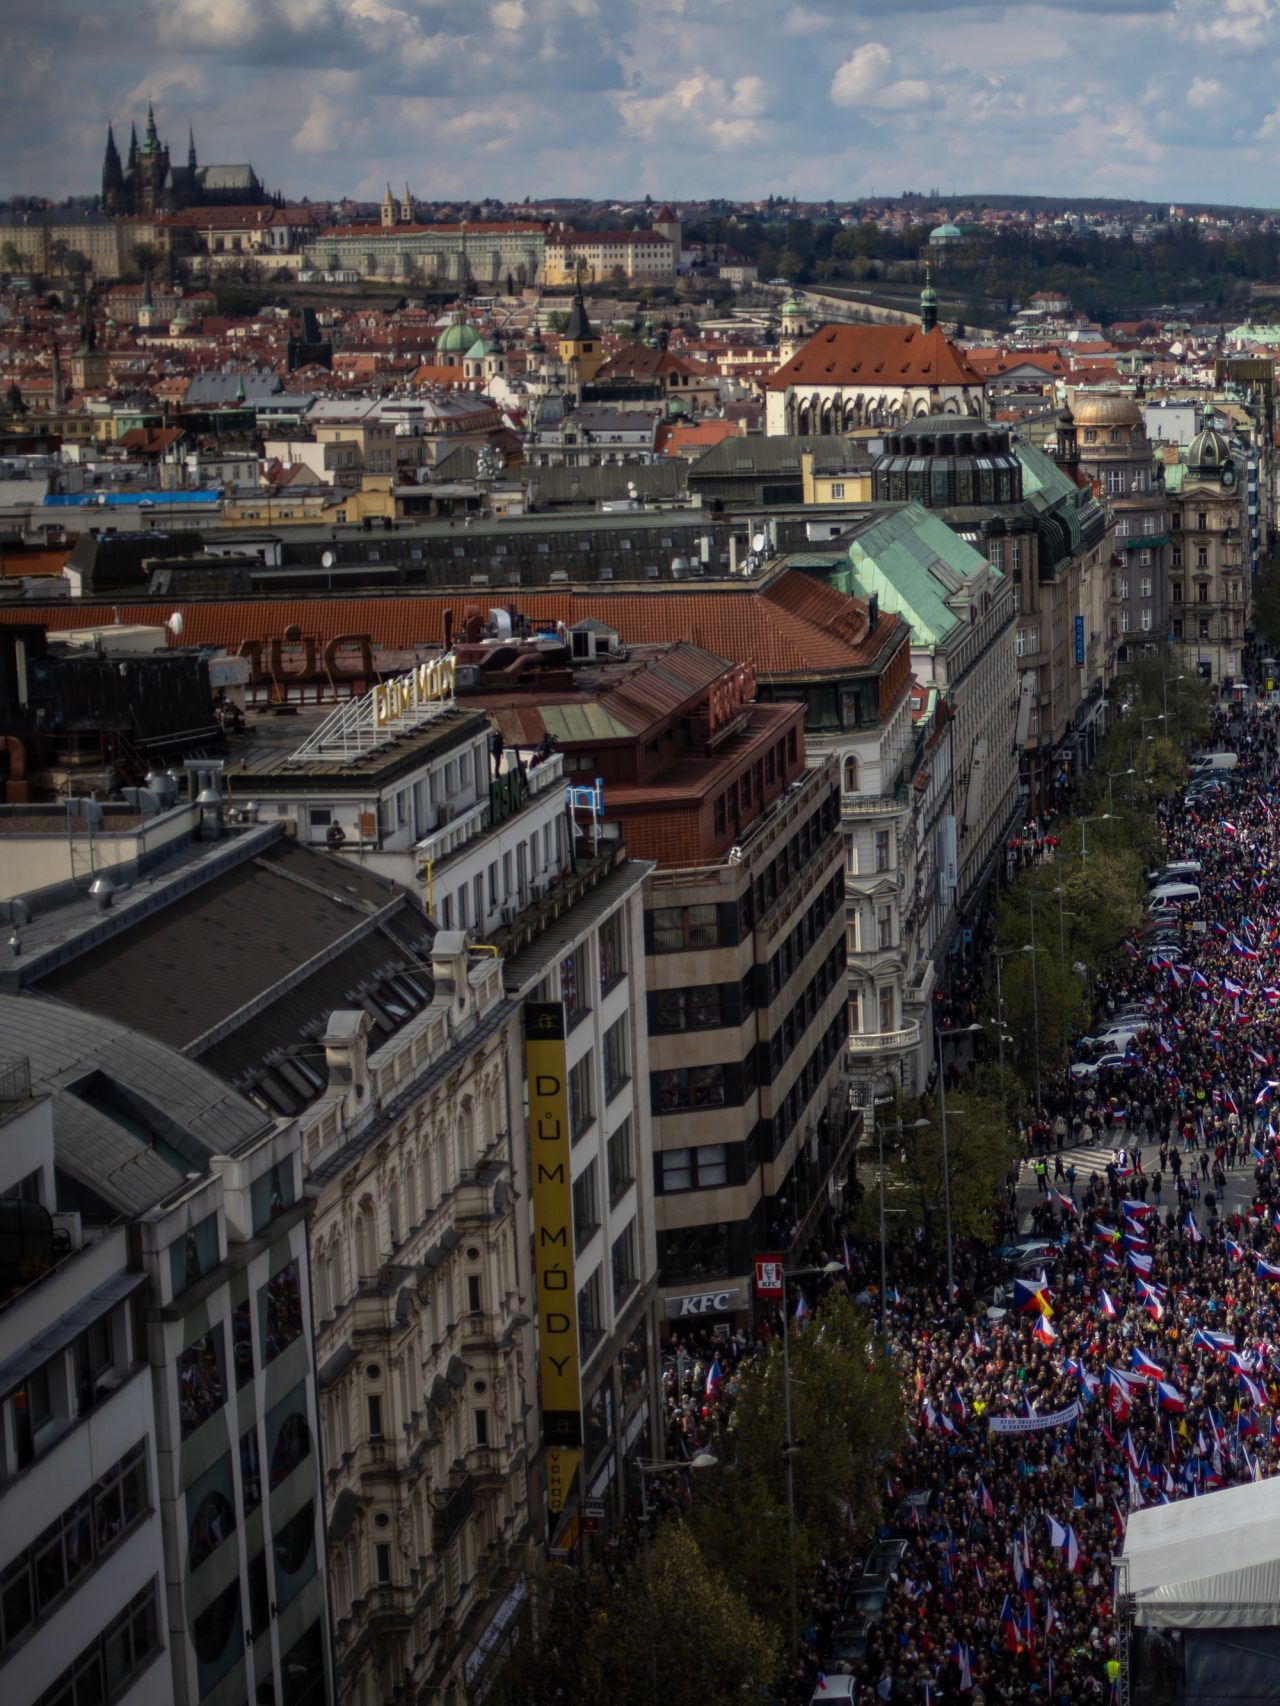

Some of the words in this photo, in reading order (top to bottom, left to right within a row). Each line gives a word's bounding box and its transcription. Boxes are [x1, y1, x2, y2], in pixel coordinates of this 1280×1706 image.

[535, 1075, 565, 1185] DŮM
[540, 1226, 571, 1377] MÓDY
[680, 1293, 730, 1316] KFC
[550, 1453, 562, 1509] VCHOD
